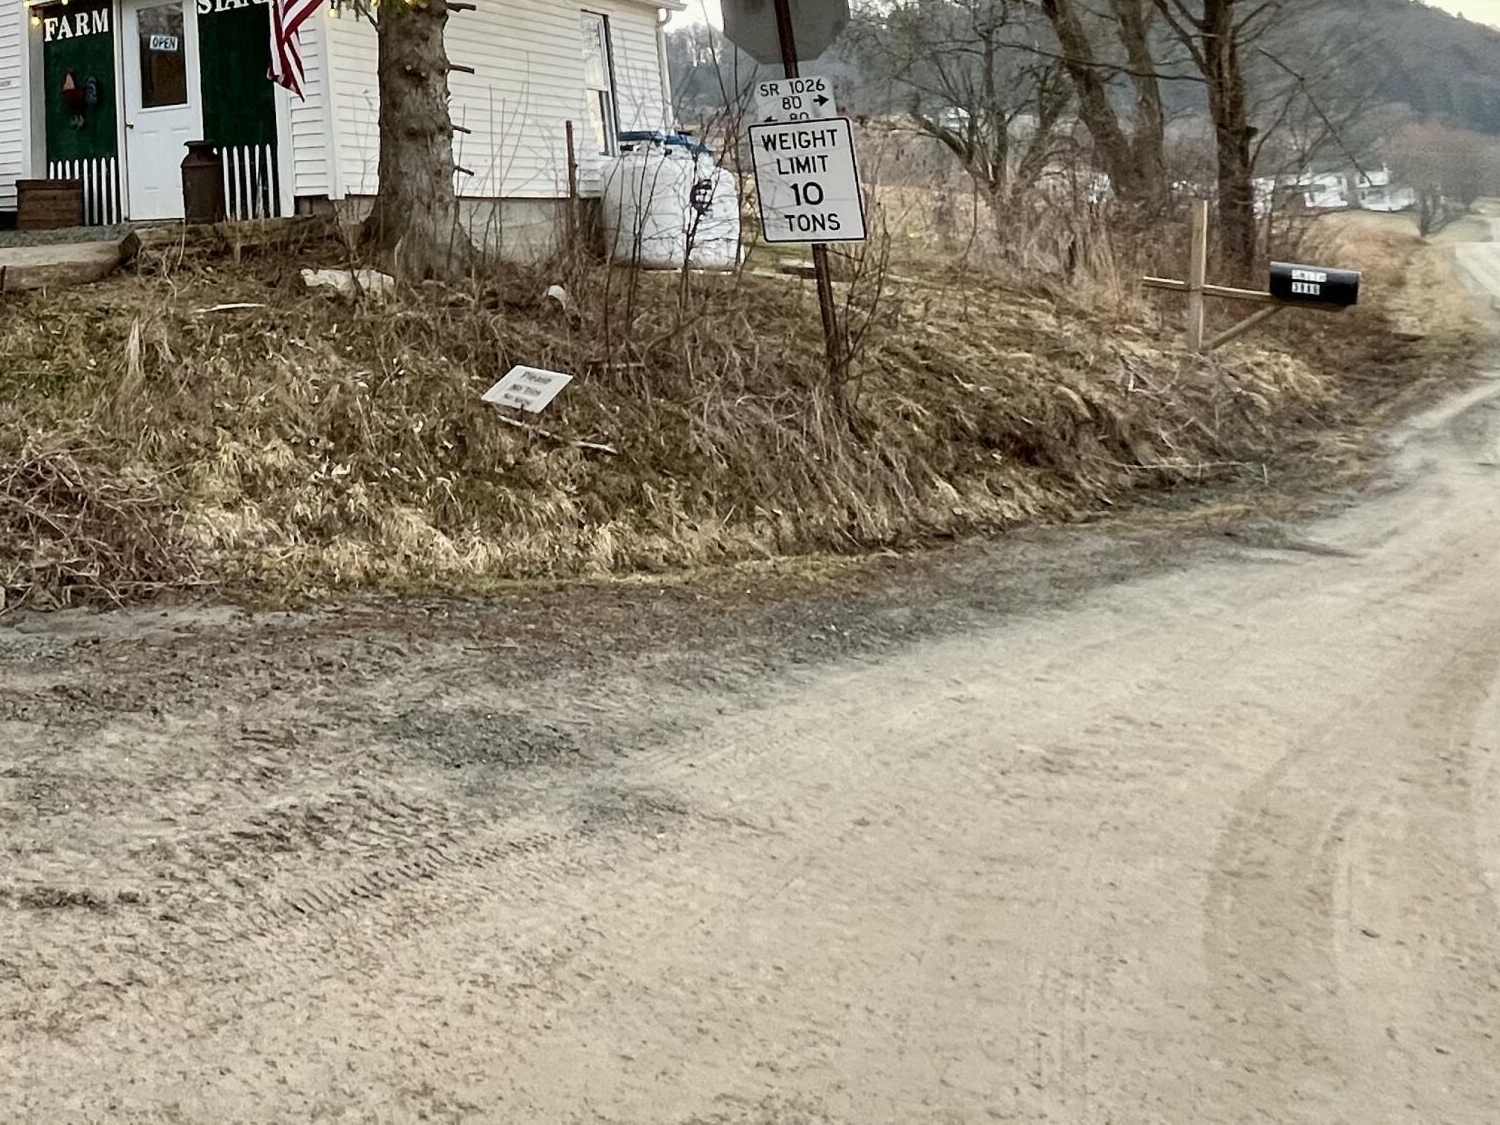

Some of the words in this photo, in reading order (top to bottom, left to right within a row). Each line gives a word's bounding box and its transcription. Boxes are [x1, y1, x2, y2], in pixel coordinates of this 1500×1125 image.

[43, 8, 109, 42] FARM
[152, 37, 175, 49] OPEN
[760, 83, 779, 97] SR
[789, 78, 826, 95] 1026
[782, 96, 802, 110] 80
[761, 129, 838, 151] WEIGHT
[776, 155, 828, 175] LIMIT
[790, 182, 824, 206] 10
[785, 213, 841, 232] TONS
